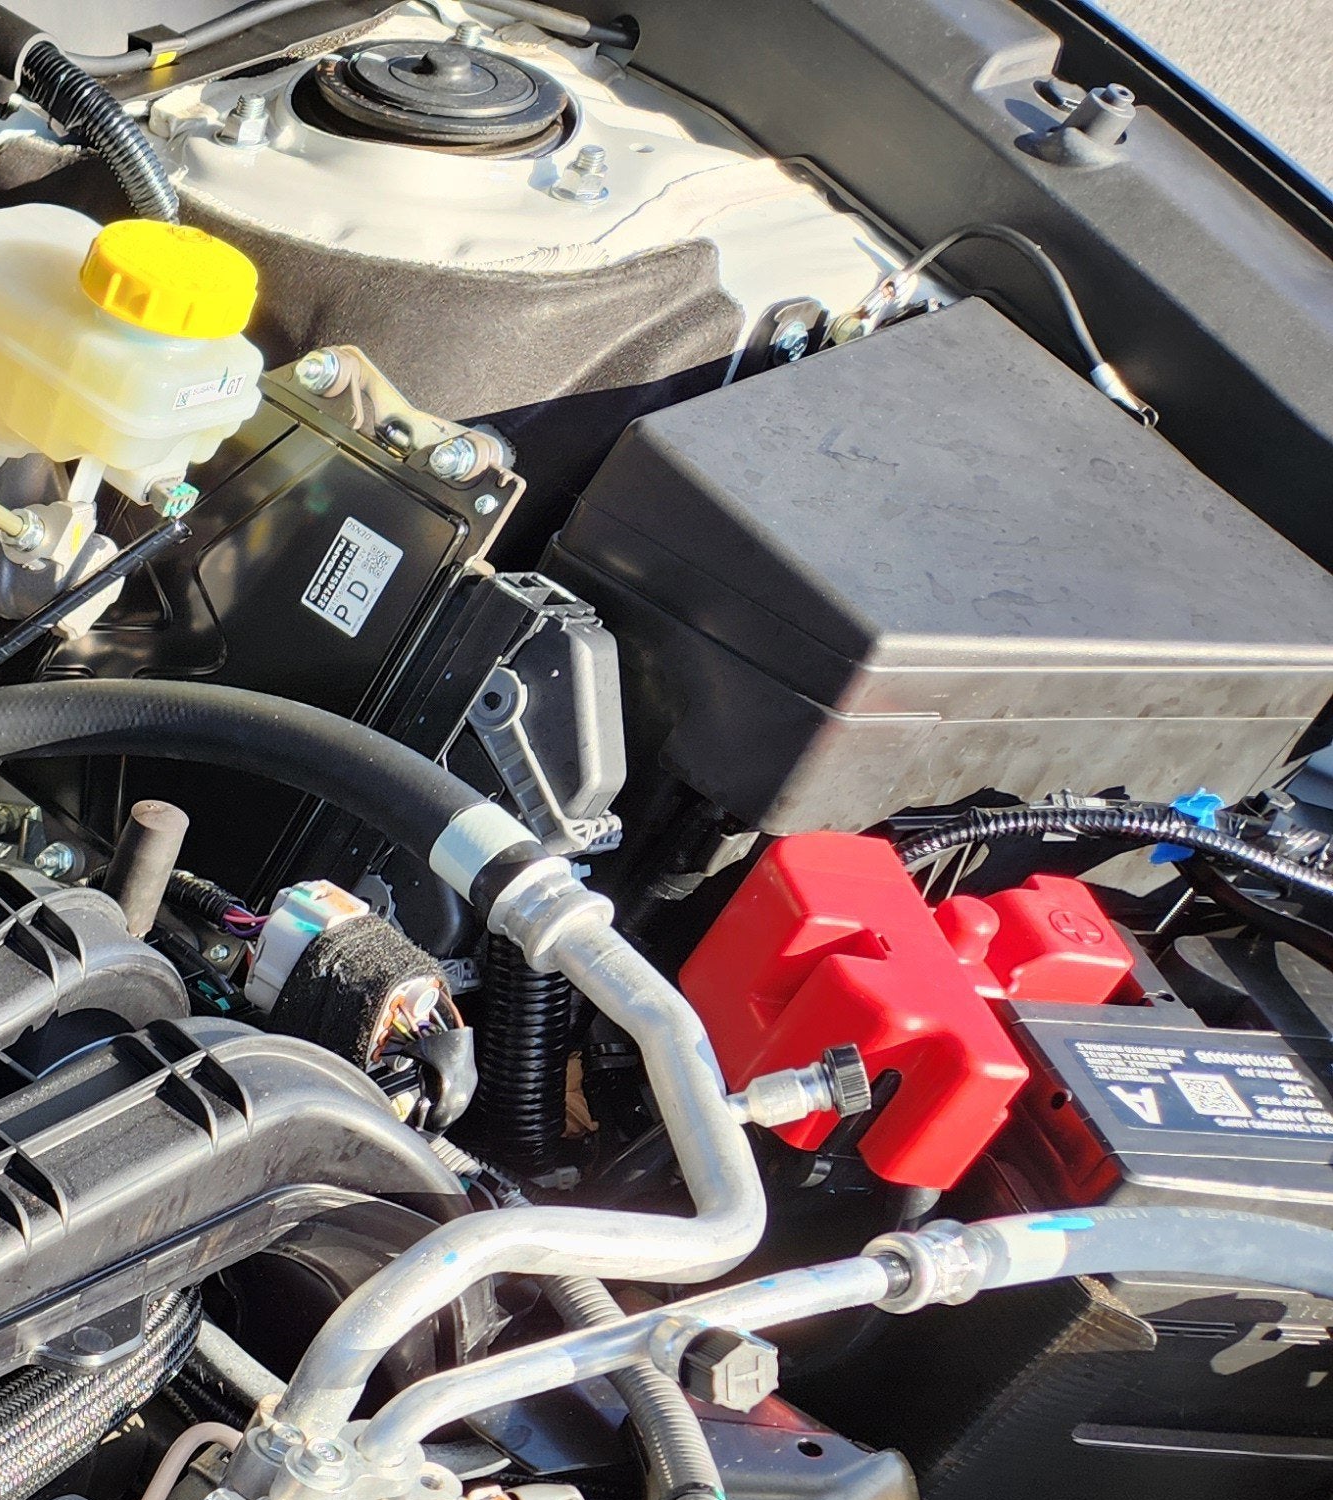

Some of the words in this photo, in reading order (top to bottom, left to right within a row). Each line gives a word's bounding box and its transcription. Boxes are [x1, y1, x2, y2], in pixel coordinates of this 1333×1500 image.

[346, 521, 372, 542] DENSO
[316, 539, 348, 586] SUBARU
[334, 604, 352, 627] P
[347, 579, 370, 602] D
[1107, 1085, 1162, 1125] A
